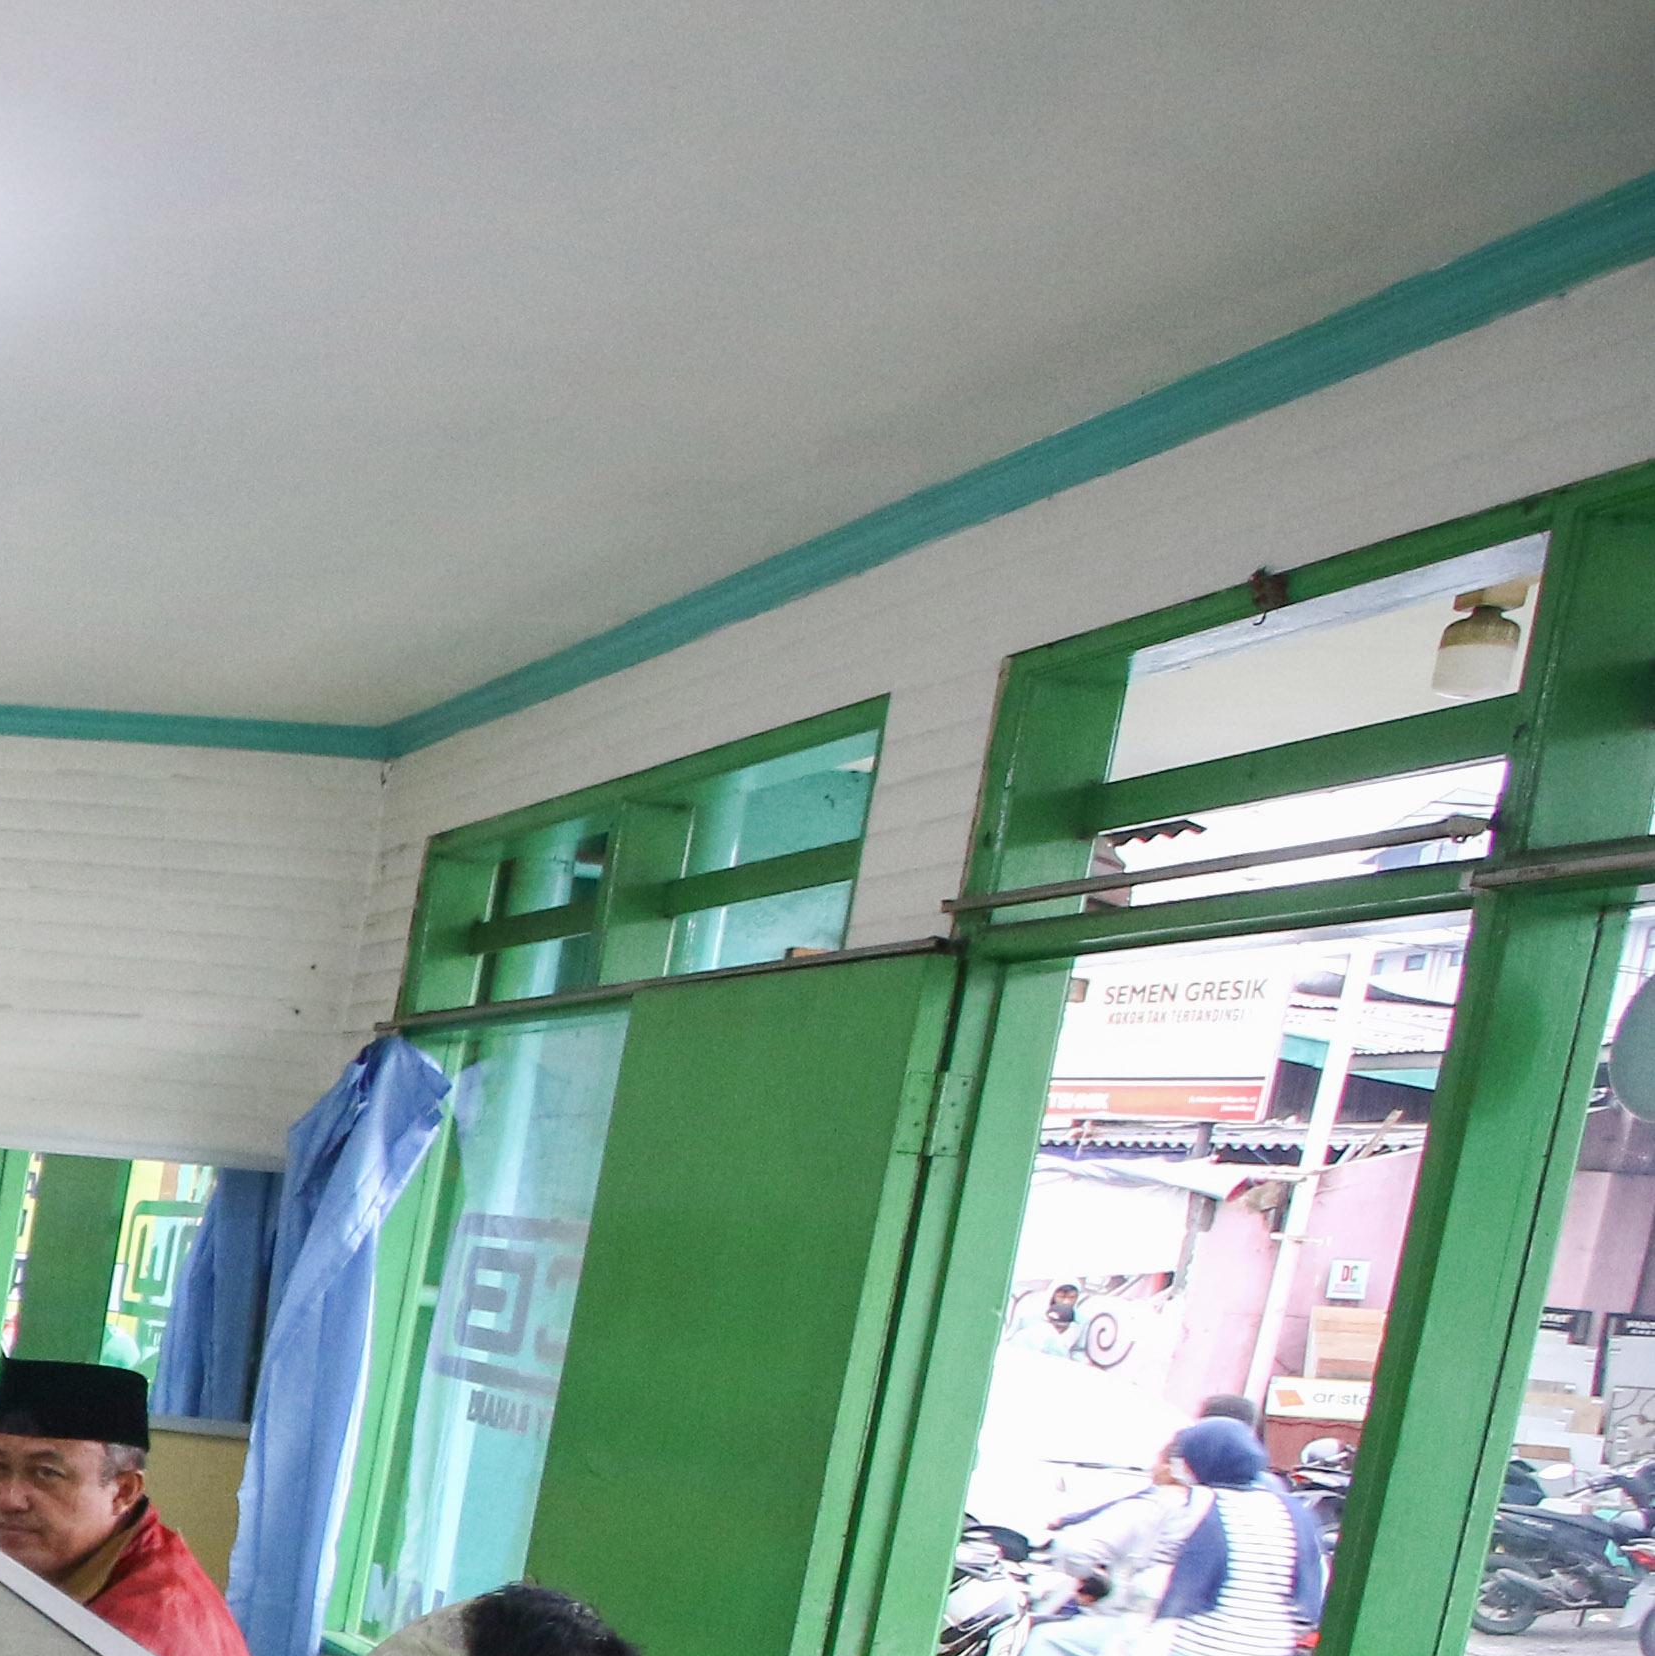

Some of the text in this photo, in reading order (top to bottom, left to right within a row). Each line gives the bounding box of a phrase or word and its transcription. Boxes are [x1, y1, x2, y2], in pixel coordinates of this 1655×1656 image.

[1104, 978, 1269, 1005] SEMEN GRESIK
[1341, 1265, 1359, 1282] DC
